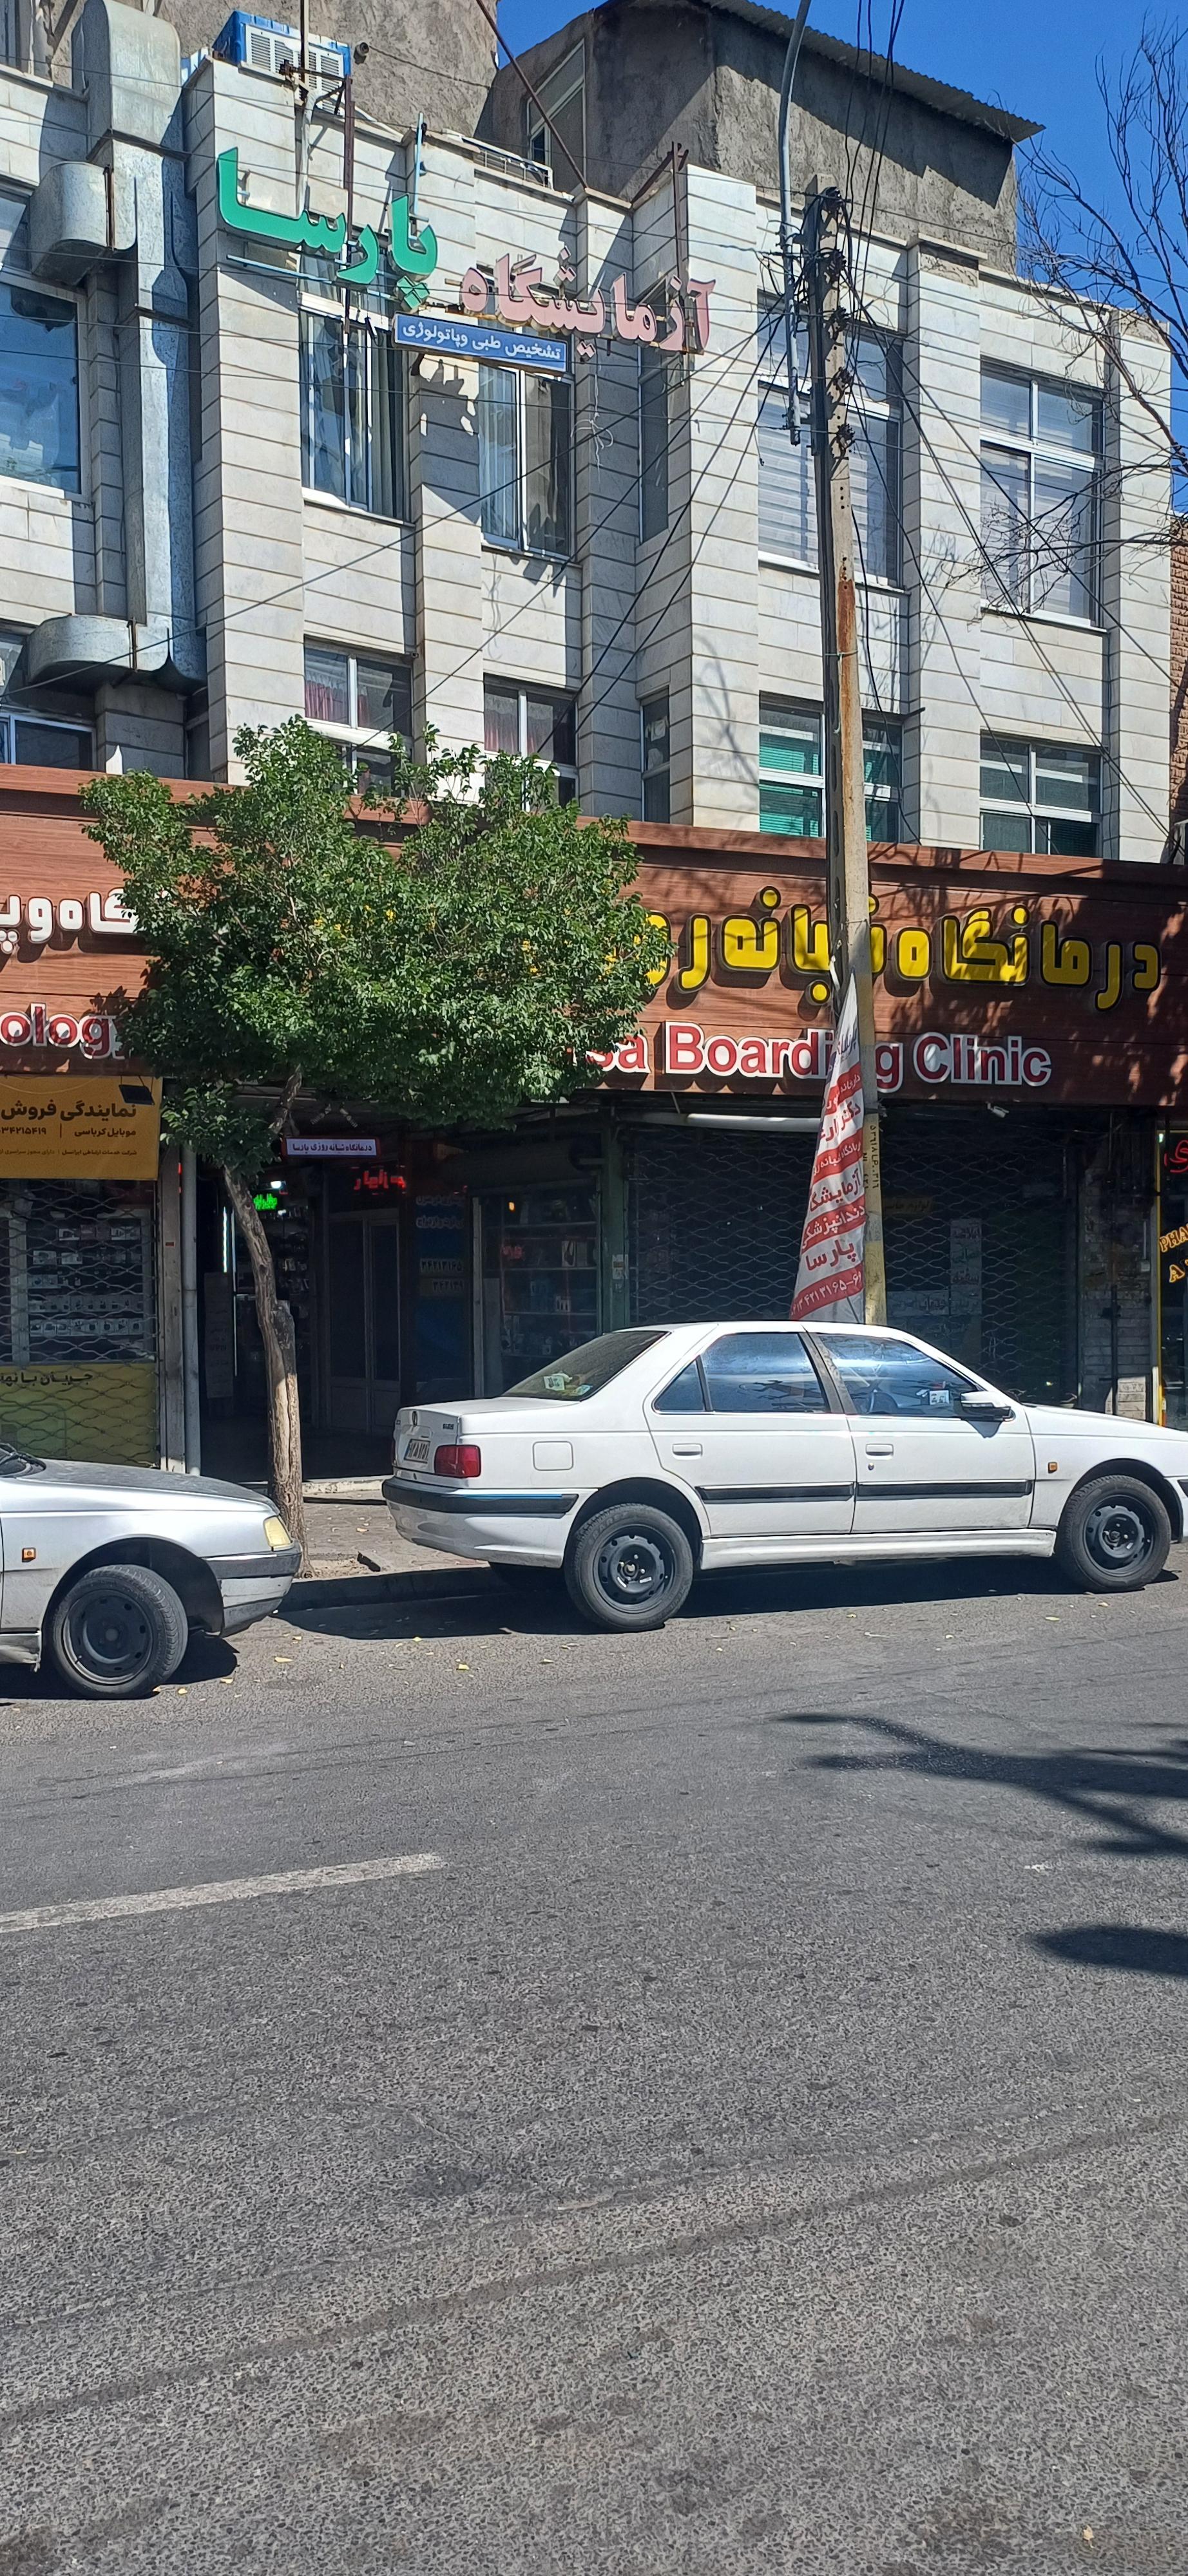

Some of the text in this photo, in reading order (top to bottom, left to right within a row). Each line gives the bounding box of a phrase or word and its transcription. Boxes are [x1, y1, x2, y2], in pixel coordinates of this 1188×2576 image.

[216, 146, 438, 310] پارسا
[459, 247, 716, 361] آزمایشگاه
[472, 335, 501, 351] طبی
[504, 342, 560, 359] تشخیص
[894, 904, 1160, 1012] درمانگاه
[664, 1021, 904, 1093] Boardig
[913, 1032, 1053, 1086] Clinic
[1, 1099, 137, 1121] نمایندگی فروش
[0, 1126, 47, 1135] ۳۴۲۱۵۴۱۹
[107, 1128, 137, 1138] موبایل
[1160, 1223, 1188, 1253] PHA
[805, 1239, 857, 1271] پارسا
